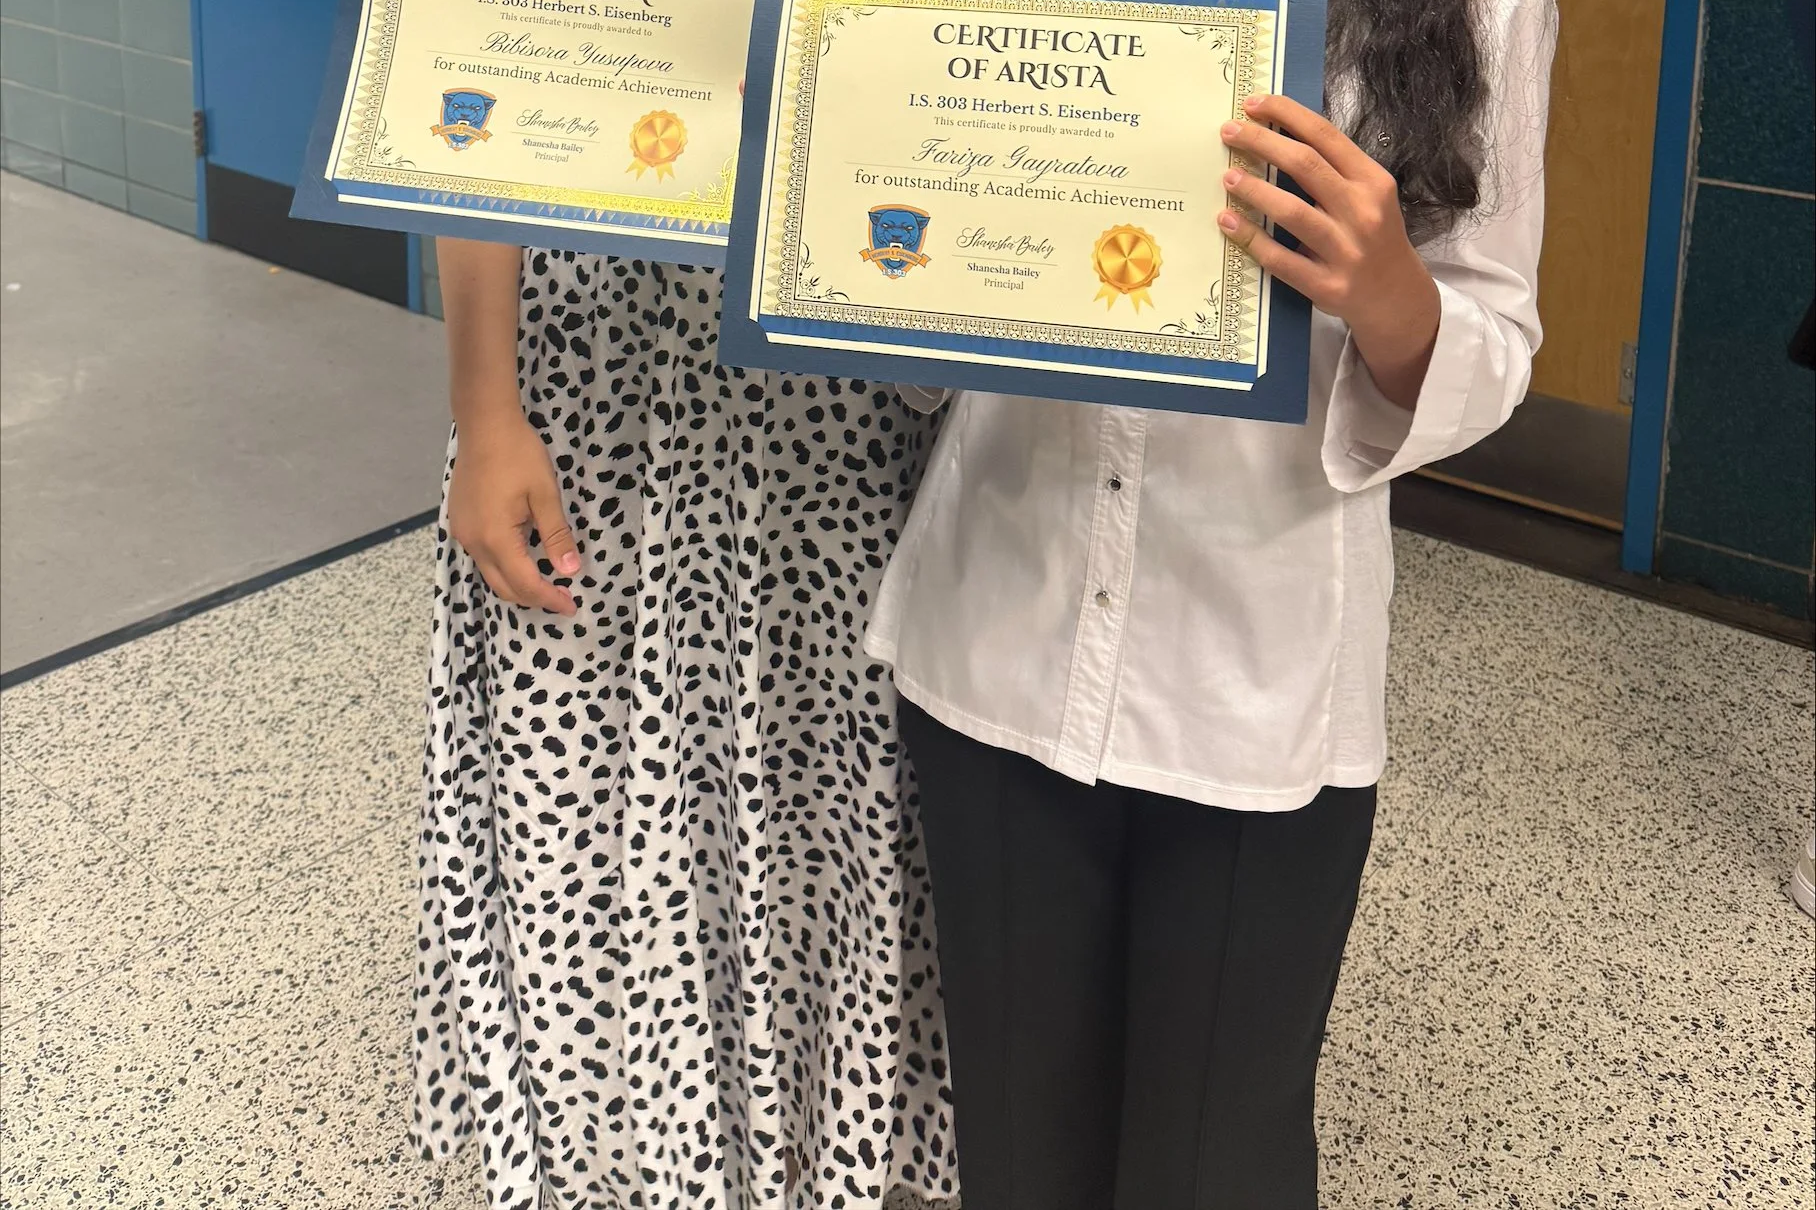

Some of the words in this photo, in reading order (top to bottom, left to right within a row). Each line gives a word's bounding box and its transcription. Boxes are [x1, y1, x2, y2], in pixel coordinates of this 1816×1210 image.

[500, 12, 517, 22] This
[520, 15, 561, 26] certificate
[564, 19, 571, 27] is
[573, 21, 604, 32] proudly
[606, 24, 642, 36] awarded
[644, 28, 652, 36] to
[589, 5, 600, 16] S.
[604, 6, 672, 27] Eisenberg
[480, 31, 570, 60] Bibisora
[573, 42, 674, 76] Yusupova
[933, 22, 1146, 61] CERTIFICATE
[433, 56, 455, 70] for
[458, 62, 542, 84] outstanding
[544, 71, 614, 89] Academic
[618, 79, 712, 101] Achievement
[947, 57, 989, 80] OF
[996, 60, 1118, 96] ARISTA
[908, 93, 933, 107] I.S.
[937, 96, 967, 109] 303
[972, 98, 1034, 116] Herbert
[1039, 104, 1053, 117] S.
[1057, 104, 1141, 127] Eisenberg
[934, 116, 954, 127] This
[957, 119, 1006, 130] certificate
[1008, 122, 1017, 131] is
[1019, 123, 1057, 136] proudly
[1060, 126, 1101, 138] awarded
[1104, 130, 1115, 139] to
[522, 138, 559, 150] Shanesha
[560, 143, 585, 154] Bailey
[535, 151, 569, 163] Principal
[912, 138, 995, 177] Fariza
[1002, 145, 1131, 184] Gayratova
[854, 169, 879, 184] for
[883, 175, 980, 197] outstanding
[983, 181, 1066, 201] Academic
[1070, 188, 1185, 212] Achievement
[967, 262, 1011, 275] Shanesha
[1012, 267, 1041, 279] Bailey
[984, 277, 1024, 290] Principal
